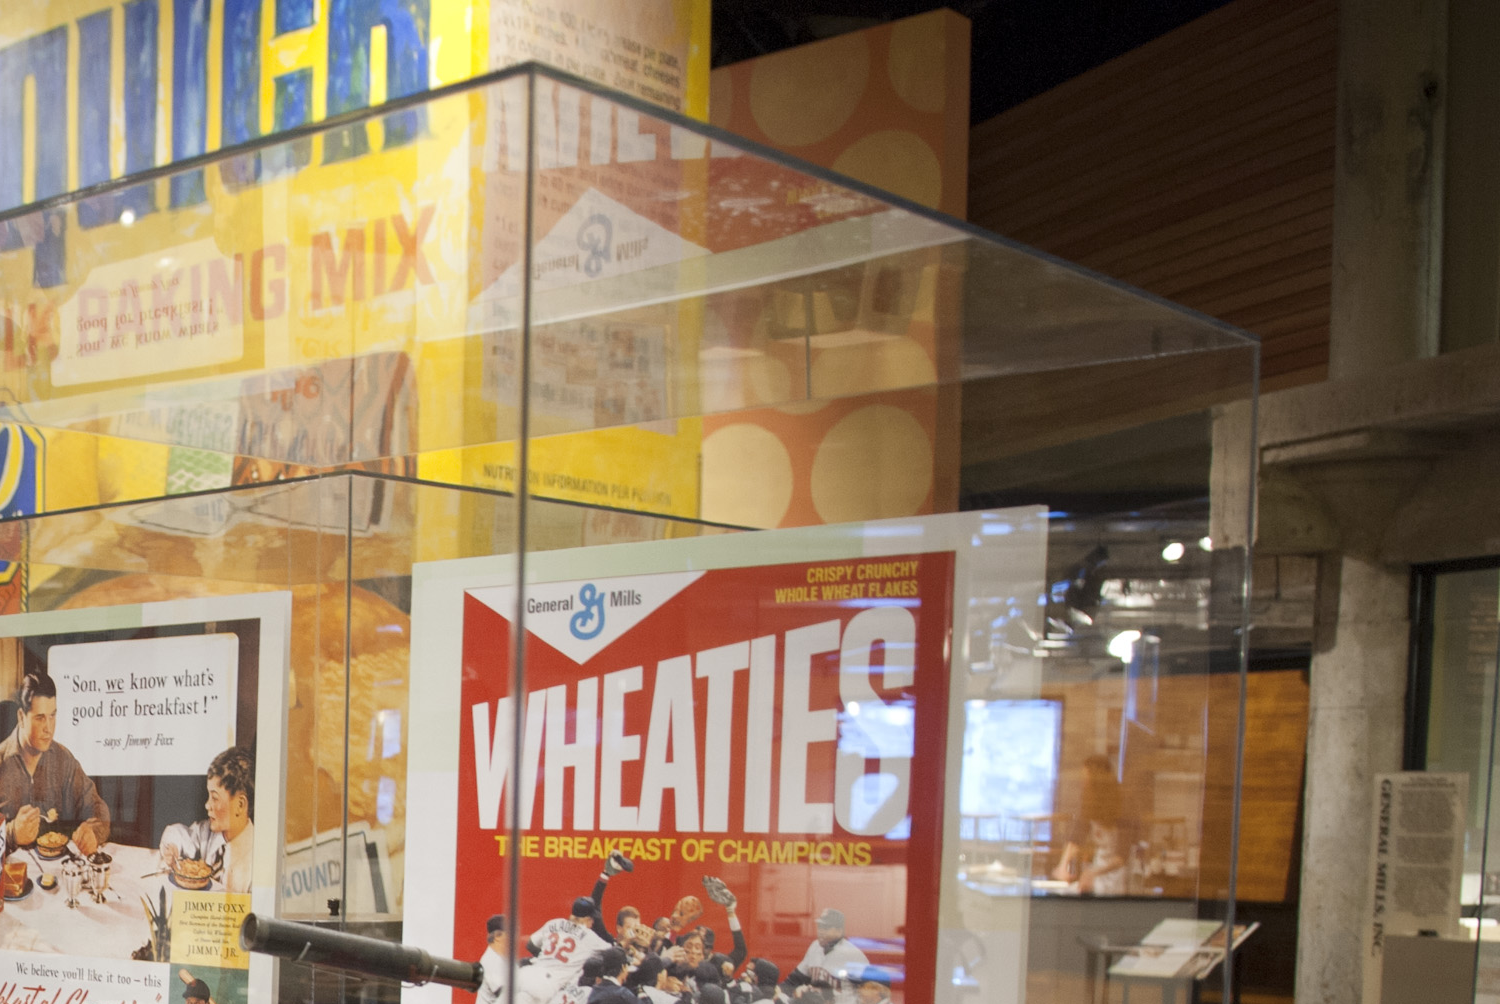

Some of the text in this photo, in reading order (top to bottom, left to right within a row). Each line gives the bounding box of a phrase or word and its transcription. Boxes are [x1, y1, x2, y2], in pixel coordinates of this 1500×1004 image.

[77, 244, 287, 358] BAKING
[311, 205, 437, 310] MIX
[806, 561, 919, 585] CRISPY CRUNCHY
[526, 590, 642, 616] General Mills
[775, 579, 919, 604] WHOLE WHEAT FLAKES
[106, 678, 124, 693] we
[130, 671, 168, 689] know
[72, 703, 103, 726] good
[110, 699, 129, 718] for
[134, 695, 199, 716] breakfast
[472, 606, 916, 836] WHEATIES
[124, 733, 175, 750] Jimmy Foxx
[1377, 779, 1392, 855] GENERAL
[544, 836, 677, 861] BREAKFAST
[682, 839, 714, 862] OF
[718, 840, 872, 867] CHAMPIONS
[183, 901, 245, 913] JIMMY FOXX
[225, 948, 238, 959] JR.
[544, 933, 576, 963] 32
[16, 962, 162, 987] We believe you'll like it too this
